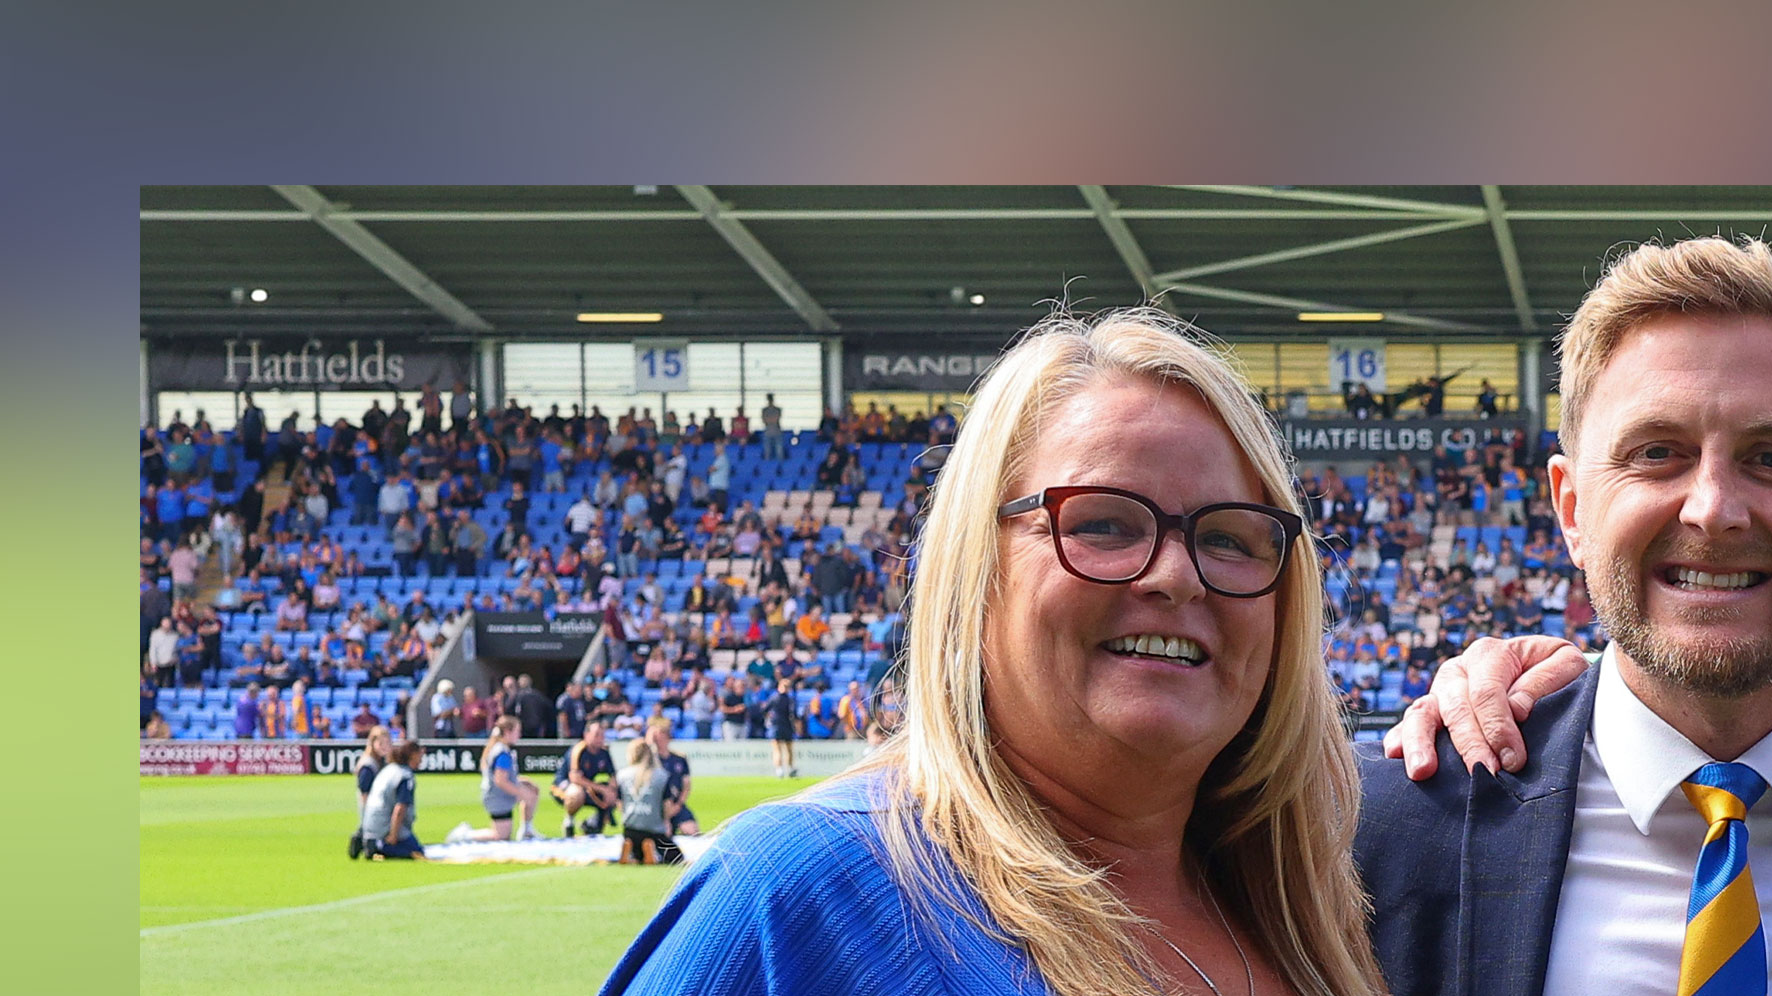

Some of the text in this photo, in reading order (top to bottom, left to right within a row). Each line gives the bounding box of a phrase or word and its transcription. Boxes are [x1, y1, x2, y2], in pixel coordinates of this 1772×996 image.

[224, 338, 405, 384] Hatfields
[642, 349, 682, 379] 15
[1337, 349, 1376, 379] 16
[418, 748, 456, 771] ushi
